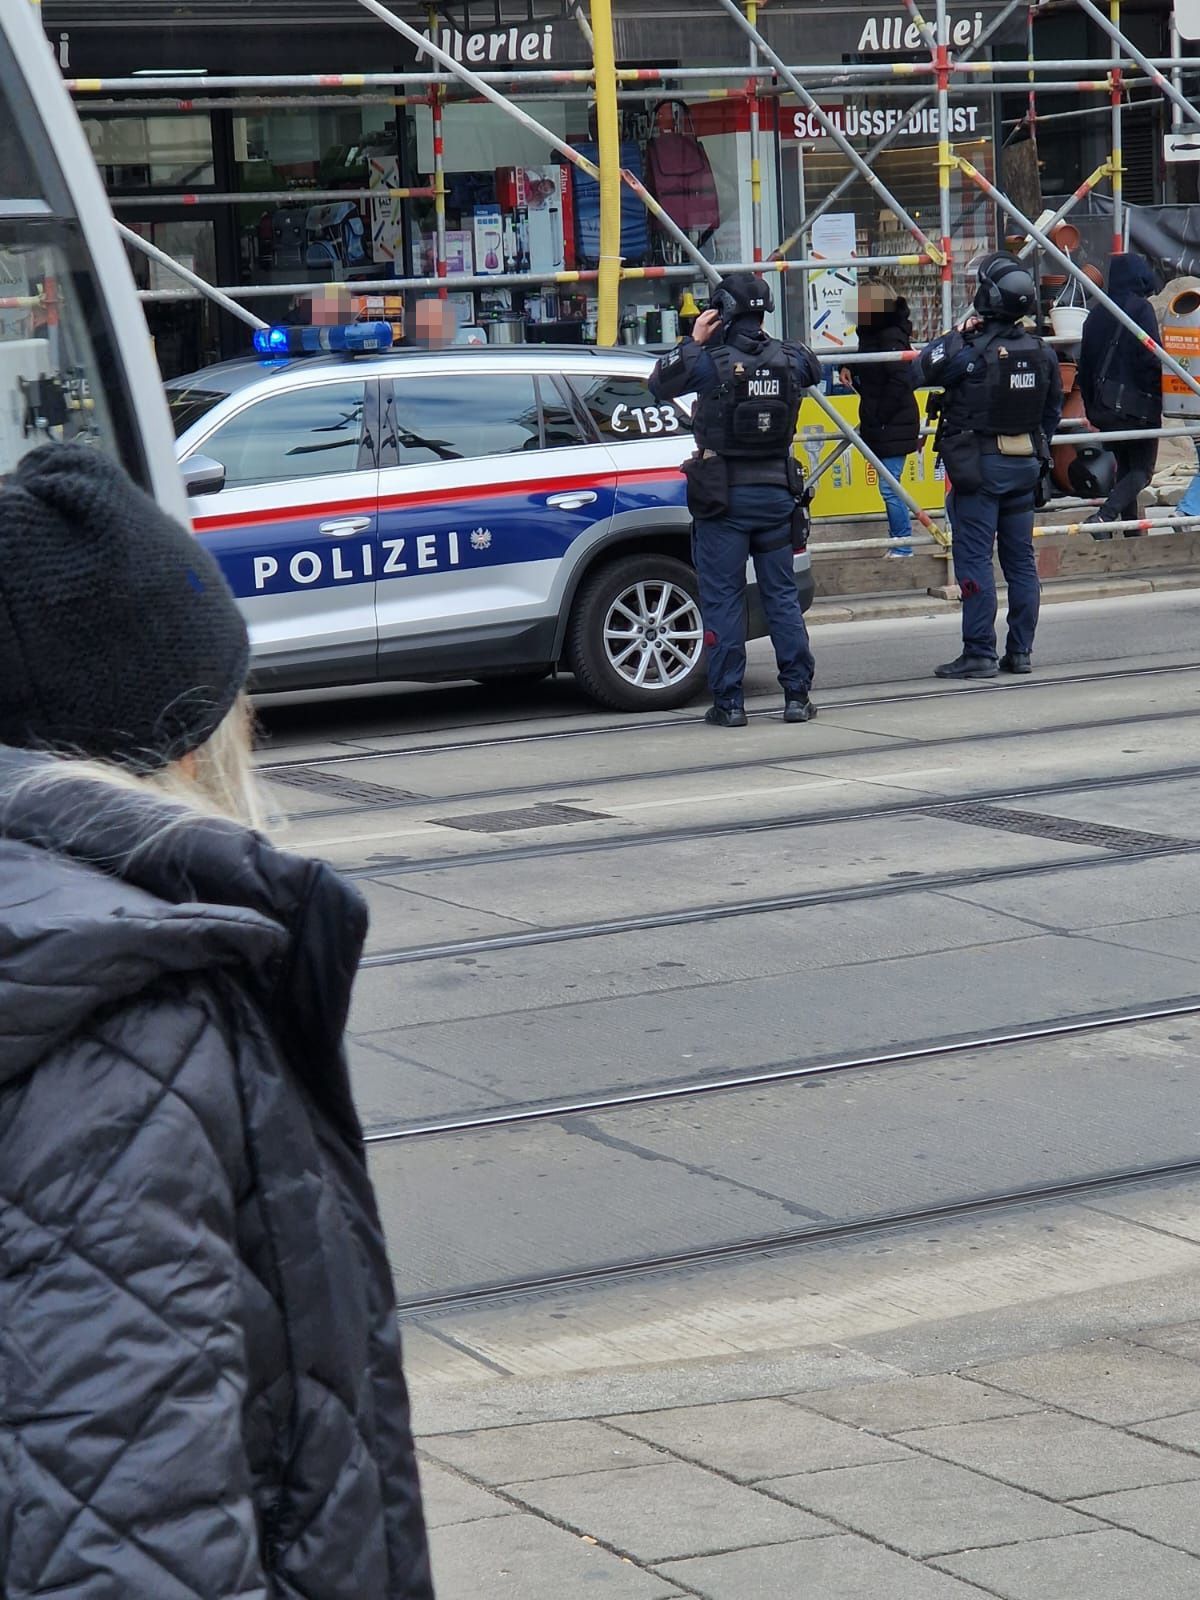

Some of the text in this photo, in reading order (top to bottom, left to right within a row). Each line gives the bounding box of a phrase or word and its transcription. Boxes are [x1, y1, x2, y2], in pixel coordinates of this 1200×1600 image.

[857, 11, 983, 51] Allerlei
[748, 379, 779, 397] POLIZEI
[1010, 373, 1035, 389] POLIZEI
[630, 405, 679, 433] 133
[253, 531, 460, 589] POLIZEI
